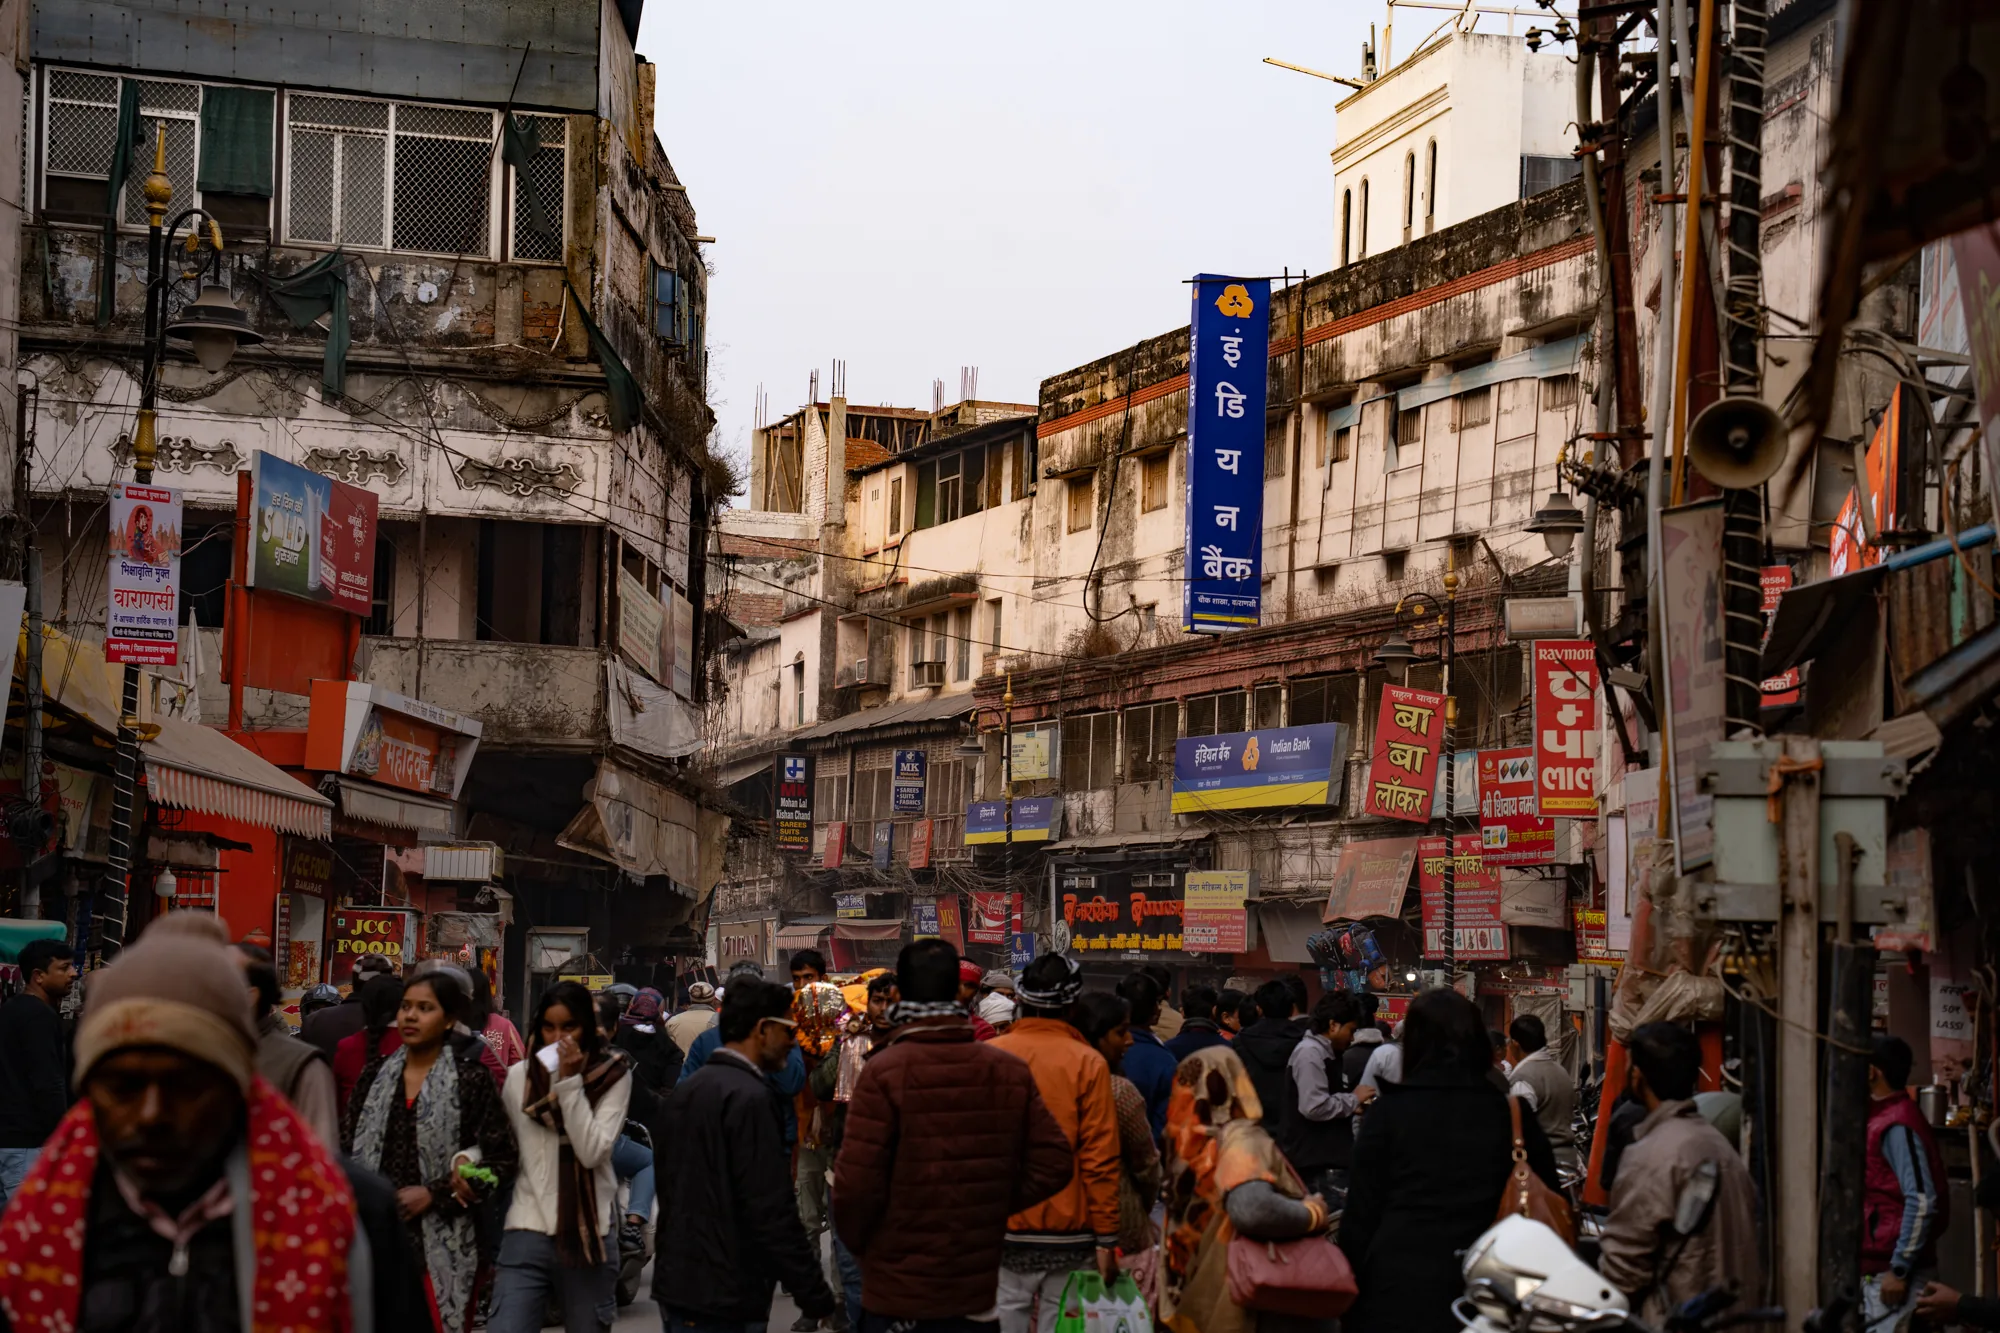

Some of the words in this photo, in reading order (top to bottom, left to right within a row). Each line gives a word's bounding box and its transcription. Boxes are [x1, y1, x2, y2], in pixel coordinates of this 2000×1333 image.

[271, 493, 281, 506] हर
[283, 492, 293, 511] दिन
[155, 568, 170, 583] मुक्त
[113, 585, 175, 611] वाराणसी
[120, 615, 135, 624] आपका
[1538, 648, 1596, 665] Raymon
[1390, 689, 1413, 702] राहुल
[1416, 693, 1440, 705] यादव
[1270, 738, 1292, 753] Indian
[1293, 736, 1311, 752] Bank
[1194, 743, 1218, 767] इंडियन
[1218, 742, 1231, 762] बैंक
[900, 762, 920, 772] MK
[781, 783, 807, 797] MK
[1373, 775, 1429, 818] लॉकर
[780, 797, 798, 808] Mohan
[799, 798, 808, 808] Lal
[1482, 790, 1492, 818] श्री
[1493, 789, 1517, 818] शिवाय
[776, 809, 794, 820] Kishan
[794, 810, 811, 821] Chand
[780, 821, 807, 829] SAREES
[779, 835, 809, 843] FABRICS
[310, 858, 331, 881] FOOD
[1423, 857, 1445, 876] बाब
[940, 908, 956, 927] MK
[350, 918, 392, 936] JCC
[729, 934, 757, 956] TITAN
[974, 933, 993, 941] MAHADEV
[336, 938, 400, 956] FOOD
[1936, 1020, 1965, 1031] LASSI
